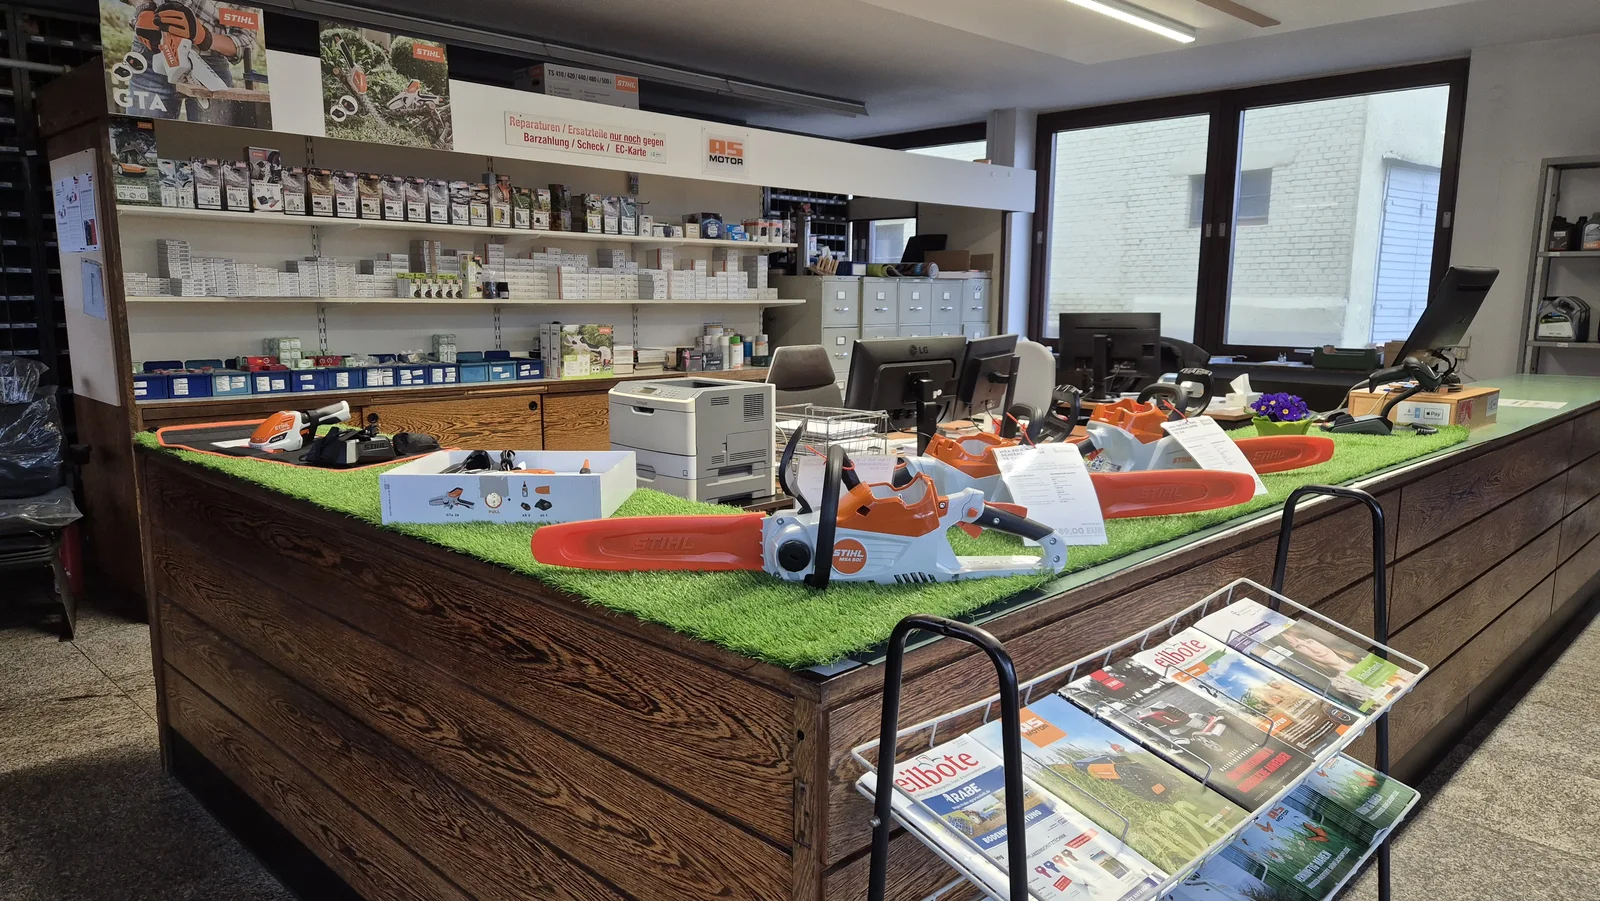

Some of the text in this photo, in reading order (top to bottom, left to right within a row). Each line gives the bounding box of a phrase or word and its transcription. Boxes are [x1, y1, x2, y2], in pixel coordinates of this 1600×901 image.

[223, 13, 256, 25] STIHL
[162, 44, 176, 65] STIHL
[416, 47, 441, 58] STIHL
[617, 79, 637, 89] STIHL
[113, 89, 168, 112] GTA
[509, 115, 560, 133] Reparaturen
[568, 124, 608, 139] Ersatzteile
[609, 132, 622, 142] nur
[623, 133, 642, 144] noch
[643, 137, 664, 148] gegen
[523, 132, 570, 149] Barzahlung
[577, 139, 605, 153] Scheck
[615, 143, 647, 157] EC-Karte
[709, 138, 744, 157] AS
[709, 154, 744, 166] MOTOR
[918, 346, 929, 355] LG
[1430, 410, 1441, 419] Pay
[274, 423, 290, 431] STIHL
[363, 442, 388, 451] STIHL
[1172, 456, 1193, 464] STIHL
[1253, 449, 1286, 462] STIHL
[1139, 486, 1182, 499] STIHL
[1086, 526, 1104, 534] EUR
[633, 535, 695, 551] STIHL
[833, 549, 864, 558] STIHL
[1154, 638, 1207, 668] eilbote
[1026, 724, 1051, 737] MOTOR
[894, 752, 980, 794] eilbote
[951, 782, 983, 805] RABE
